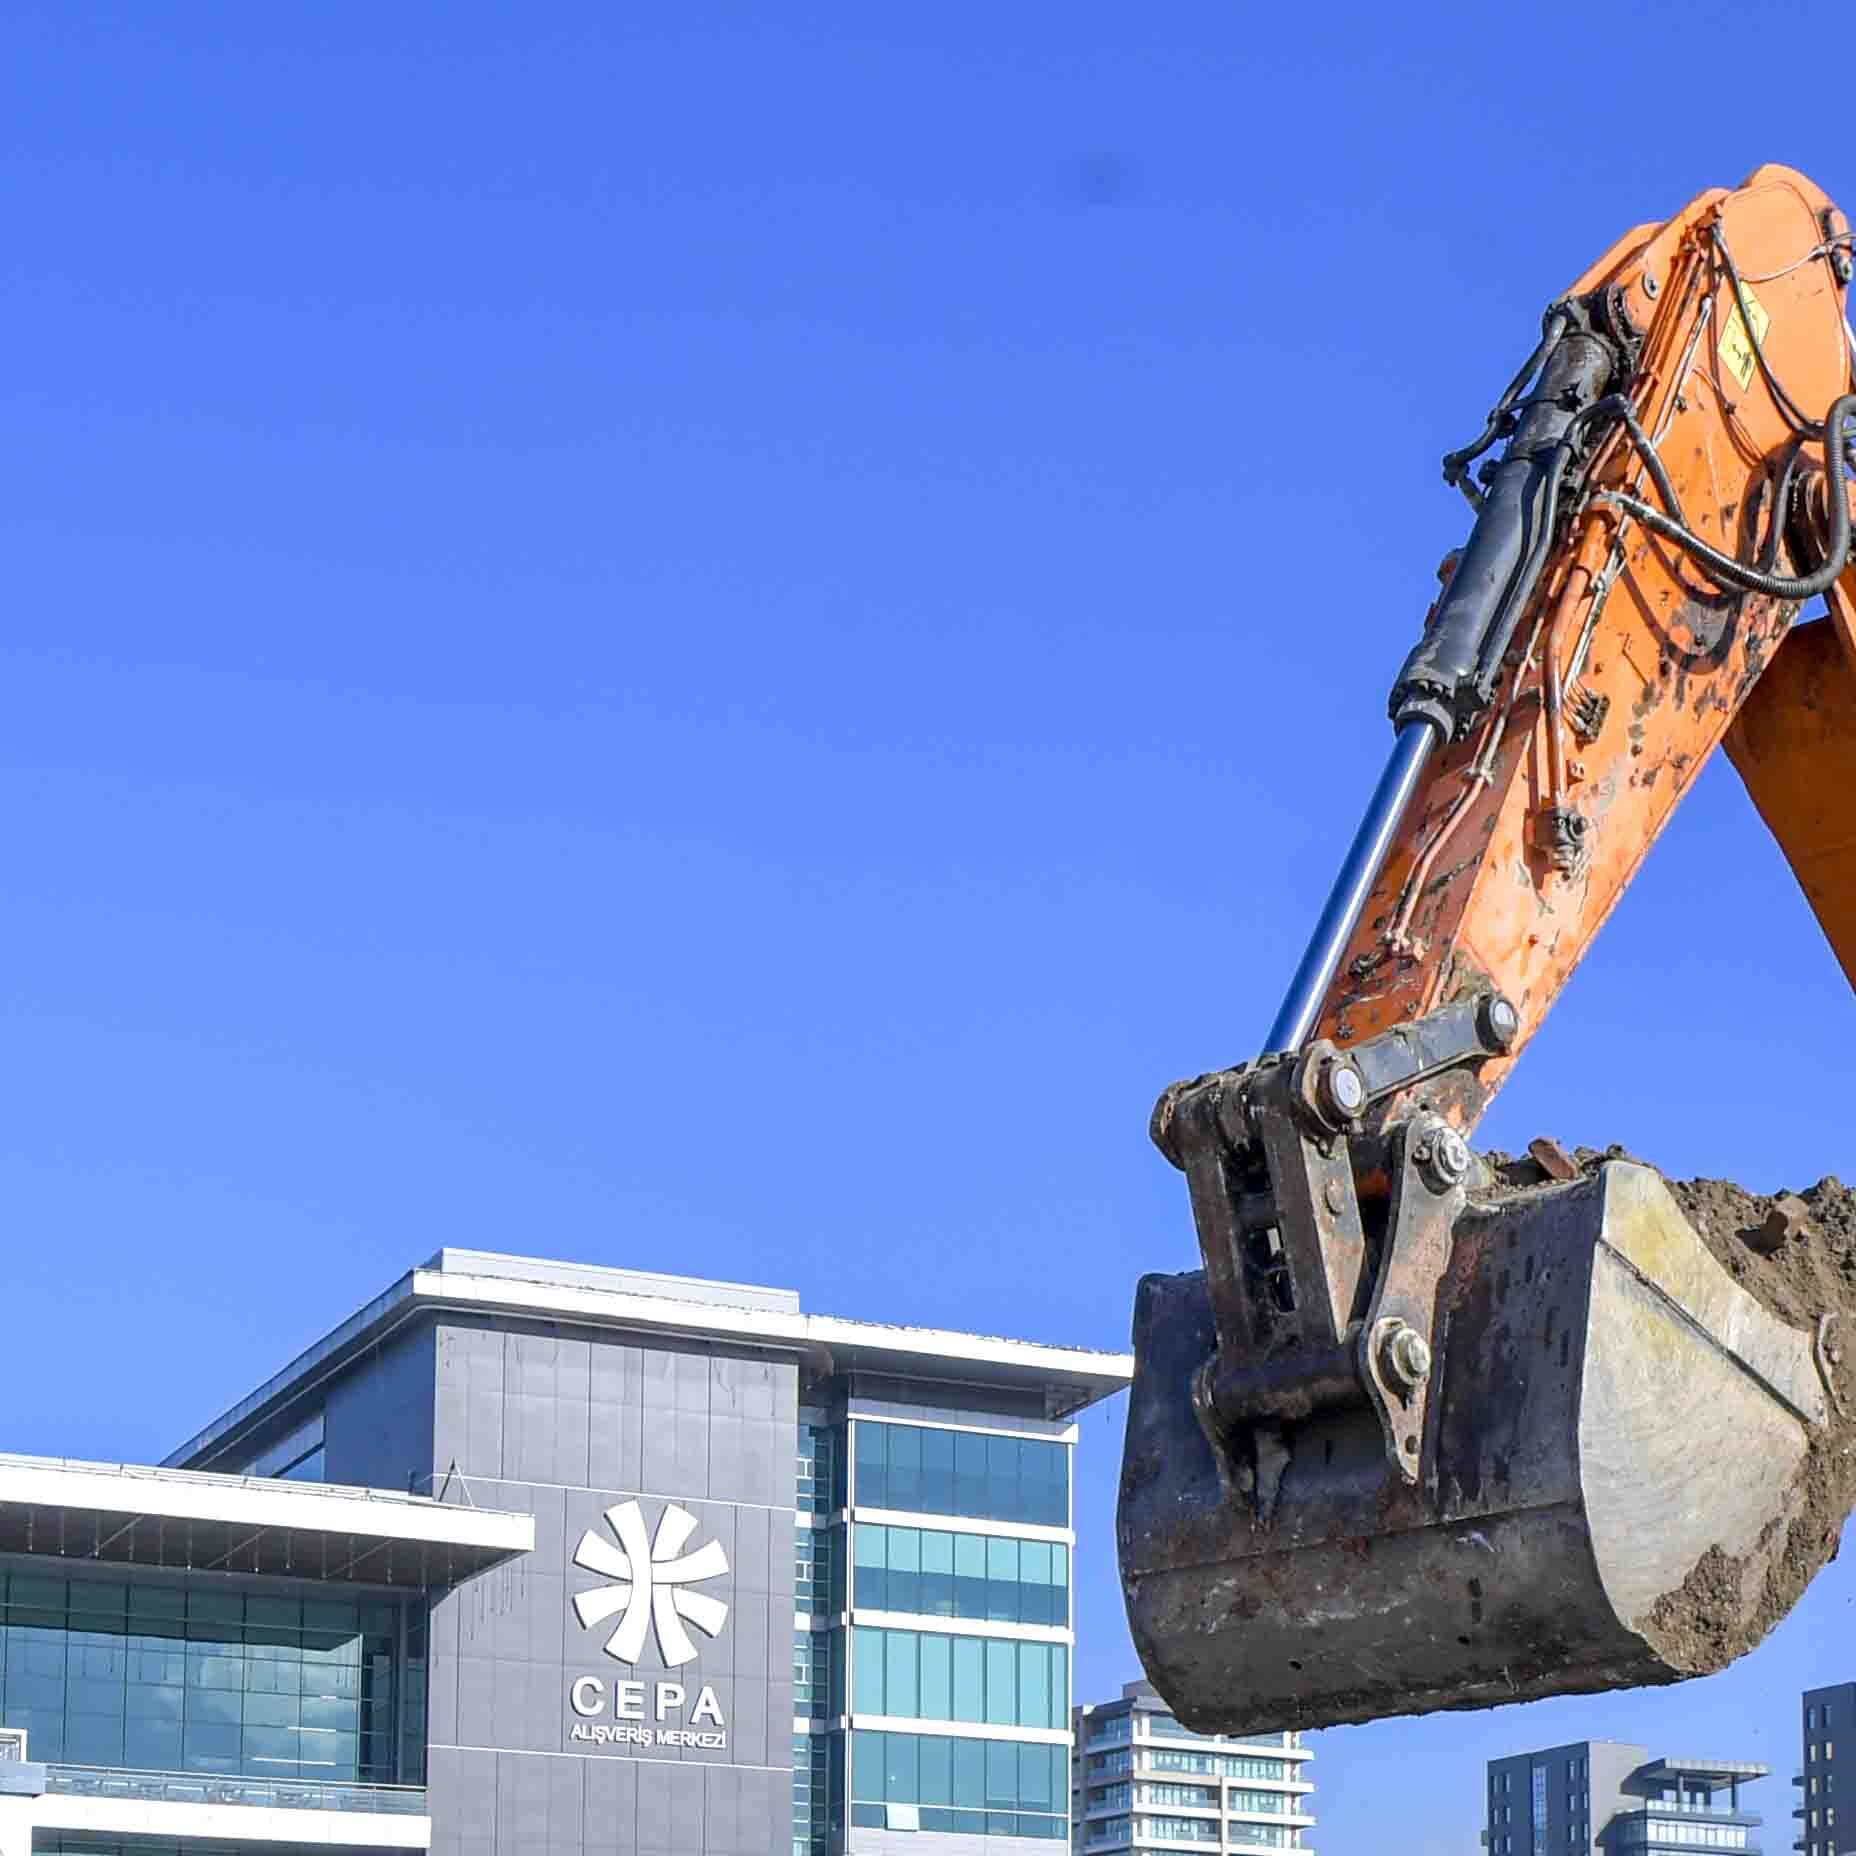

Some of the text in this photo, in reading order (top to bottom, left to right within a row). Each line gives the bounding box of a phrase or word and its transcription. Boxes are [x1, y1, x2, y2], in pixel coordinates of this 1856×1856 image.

[570, 1675, 725, 1726] CEPA
[569, 1724, 727, 1749] ALIŞVERİŞ MERKEZİ
